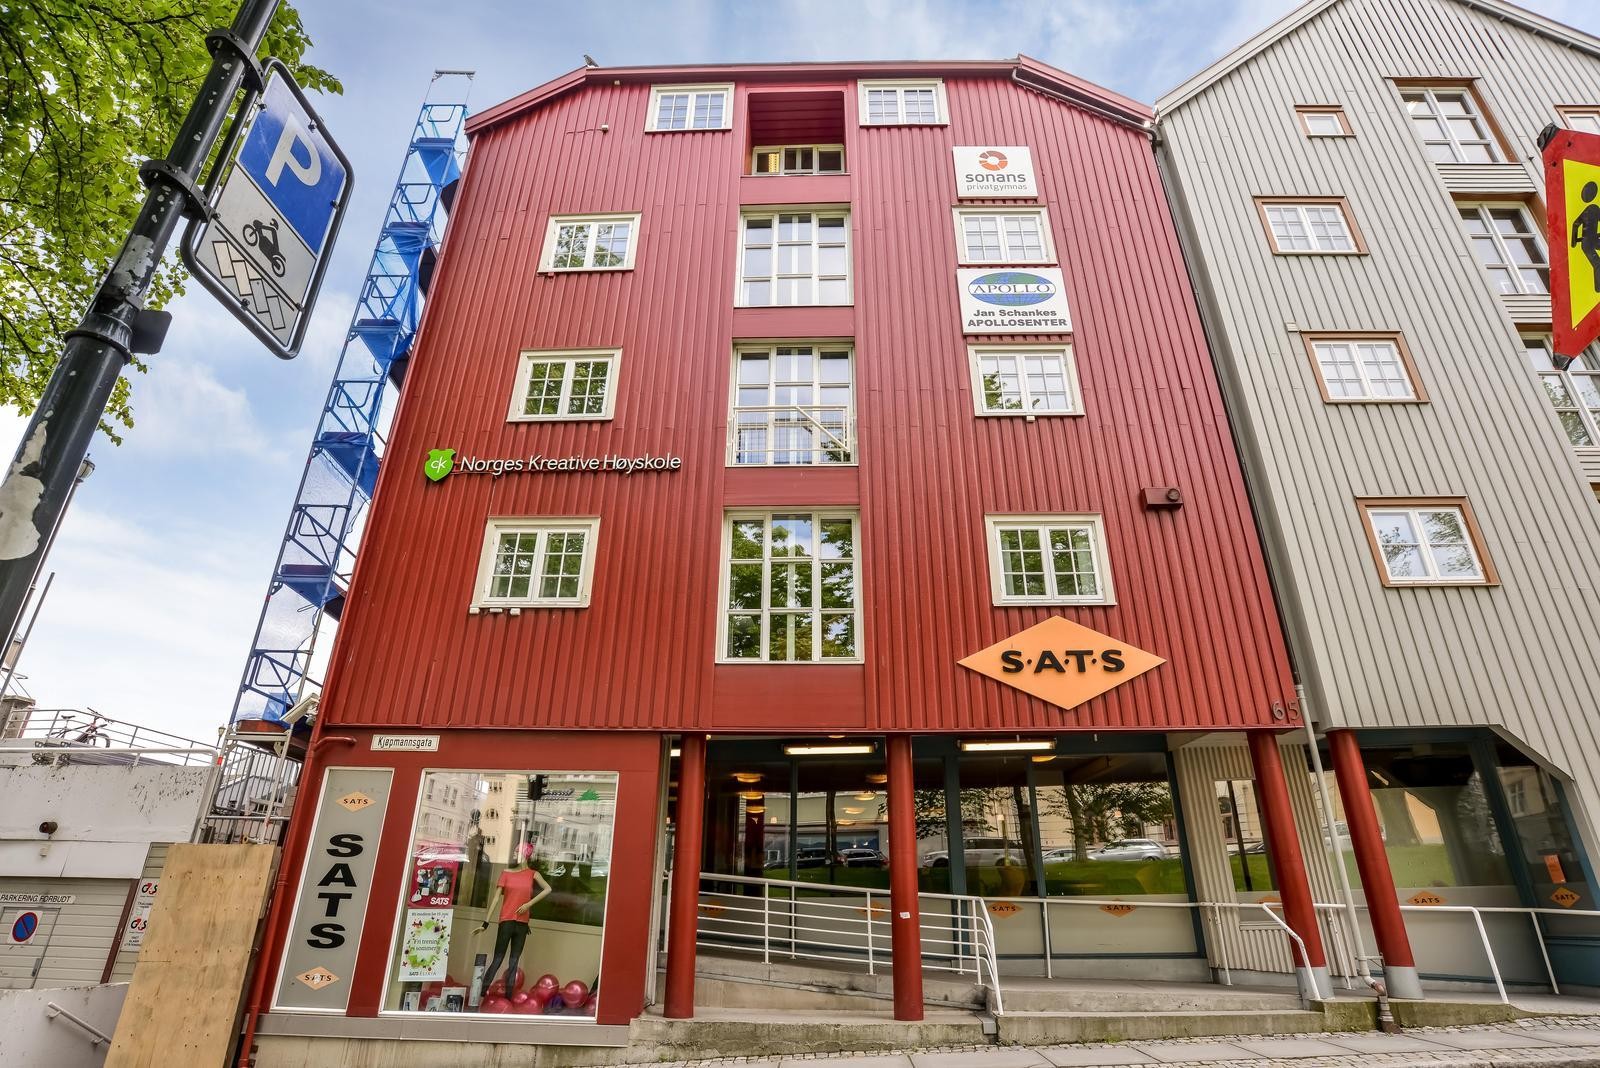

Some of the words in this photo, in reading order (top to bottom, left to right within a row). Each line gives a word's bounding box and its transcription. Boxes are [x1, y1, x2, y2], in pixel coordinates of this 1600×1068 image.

[265, 112, 321, 187] P
[965, 172, 1026, 183] sonans
[967, 183, 1028, 191] privatgymnas
[973, 284, 1050, 294] APOLLO
[973, 309, 995, 317] Jan
[998, 309, 1057, 317] Schankes
[967, 318, 1068, 327] APOLLOSENTER
[460, 455, 523, 475] Norges
[528, 453, 600, 471] Kreative
[602, 452, 682, 474] Høyskole
[1271, 701, 1300, 720] 65
[377, 736, 433, 749] Kjøpmannsgata
[0, 894, 39, 902] PARKERING
[40, 895, 71, 903] FORBUDT
[430, 897, 450, 906] SATS
